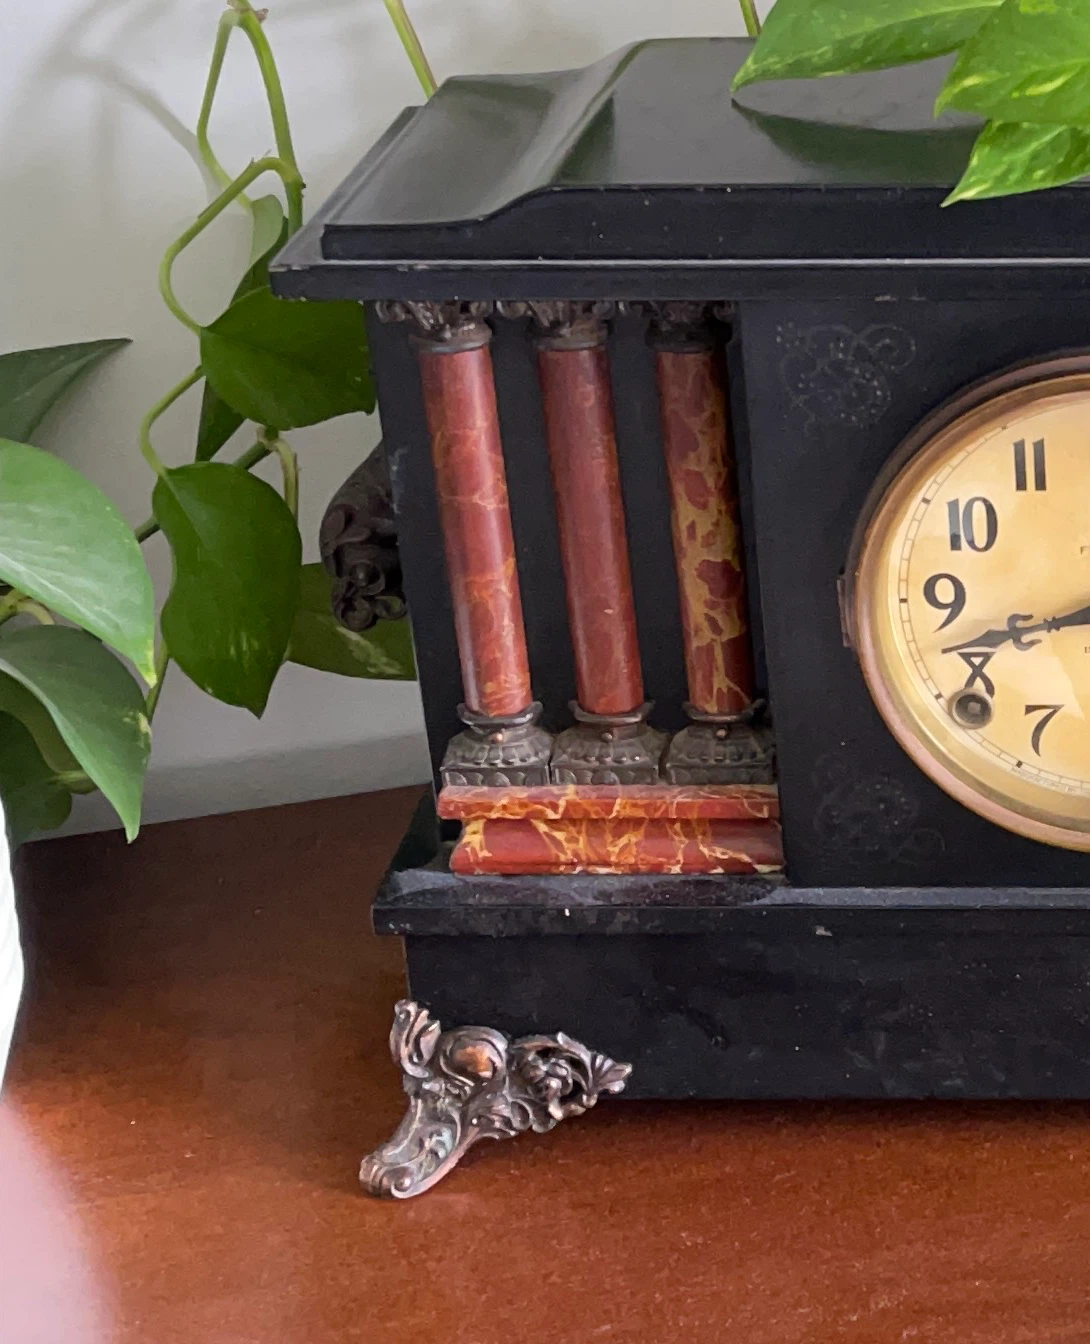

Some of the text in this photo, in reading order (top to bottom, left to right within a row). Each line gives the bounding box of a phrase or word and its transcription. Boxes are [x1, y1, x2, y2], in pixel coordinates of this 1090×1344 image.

[1013, 438, 1047, 491] 11
[946, 496, 998, 552] 10
[923, 573, 967, 633] 9
[1024, 704, 1066, 758] 7
